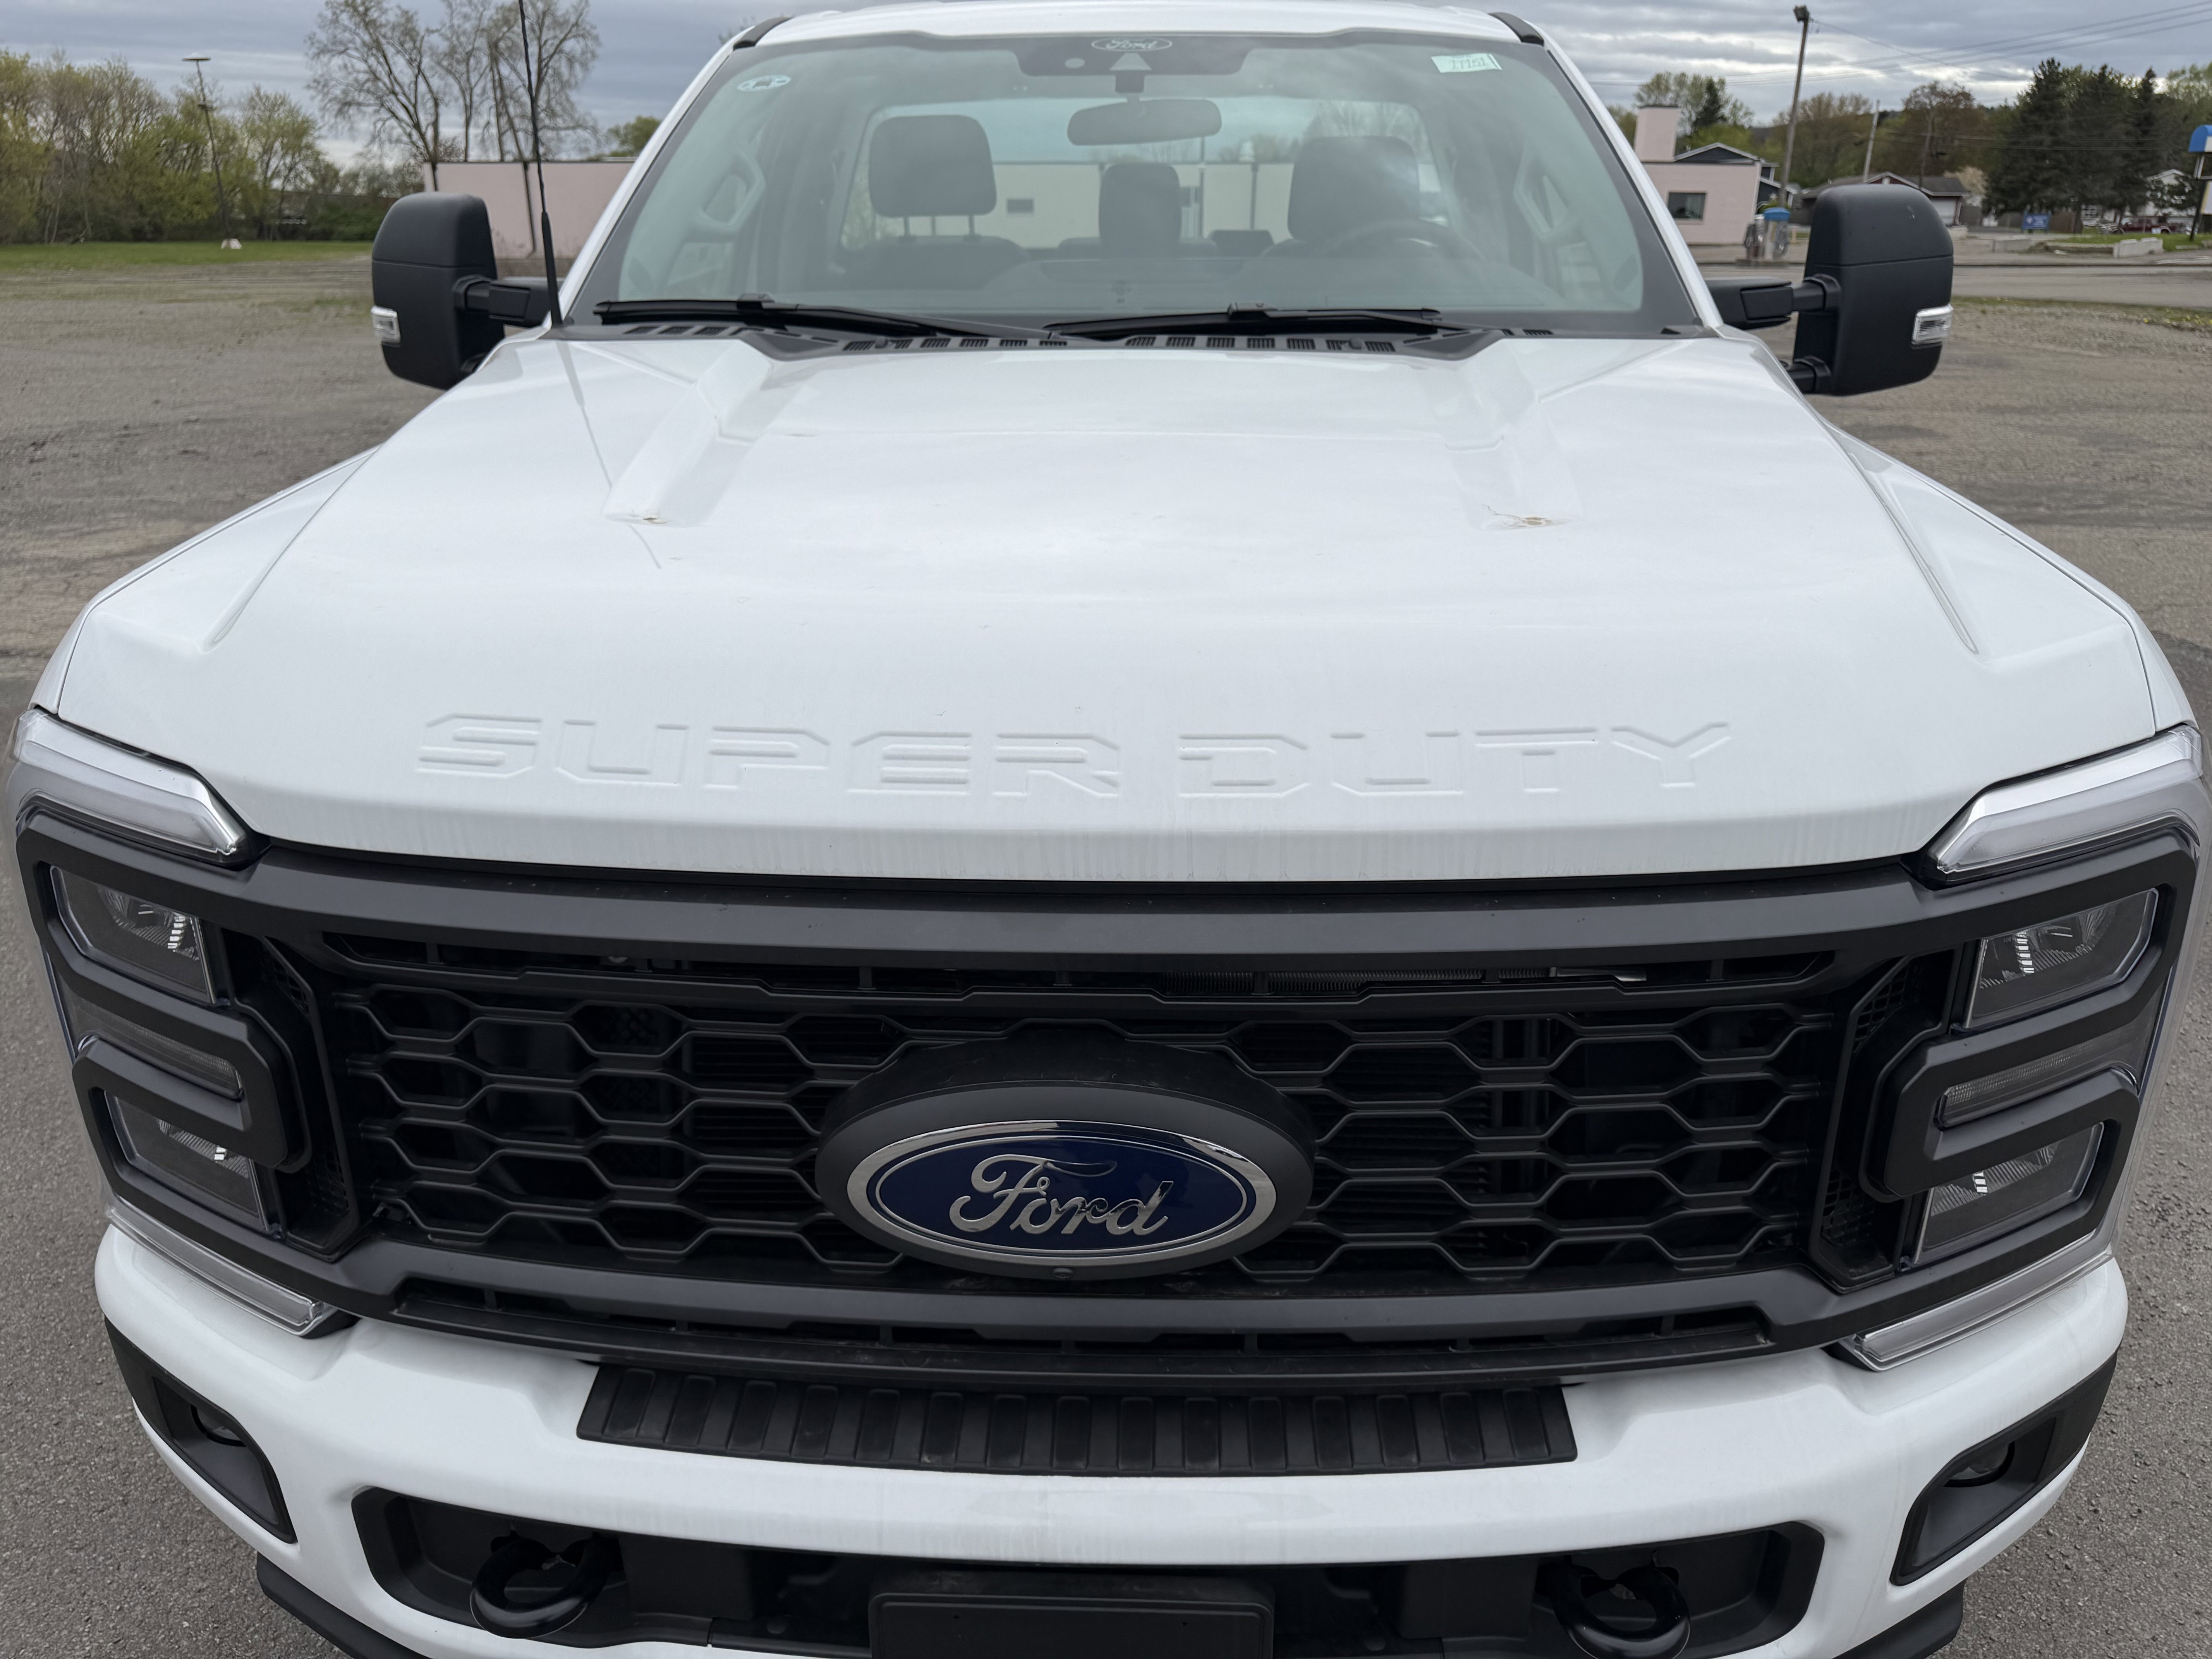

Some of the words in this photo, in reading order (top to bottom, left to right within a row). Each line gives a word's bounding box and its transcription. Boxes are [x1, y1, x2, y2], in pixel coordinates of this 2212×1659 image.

[1106, 40, 1158, 49] Ford
[416, 713, 1120, 799] SUPER
[1177, 721, 1732, 800] DUTY
[949, 1153, 1174, 1236] Ford
